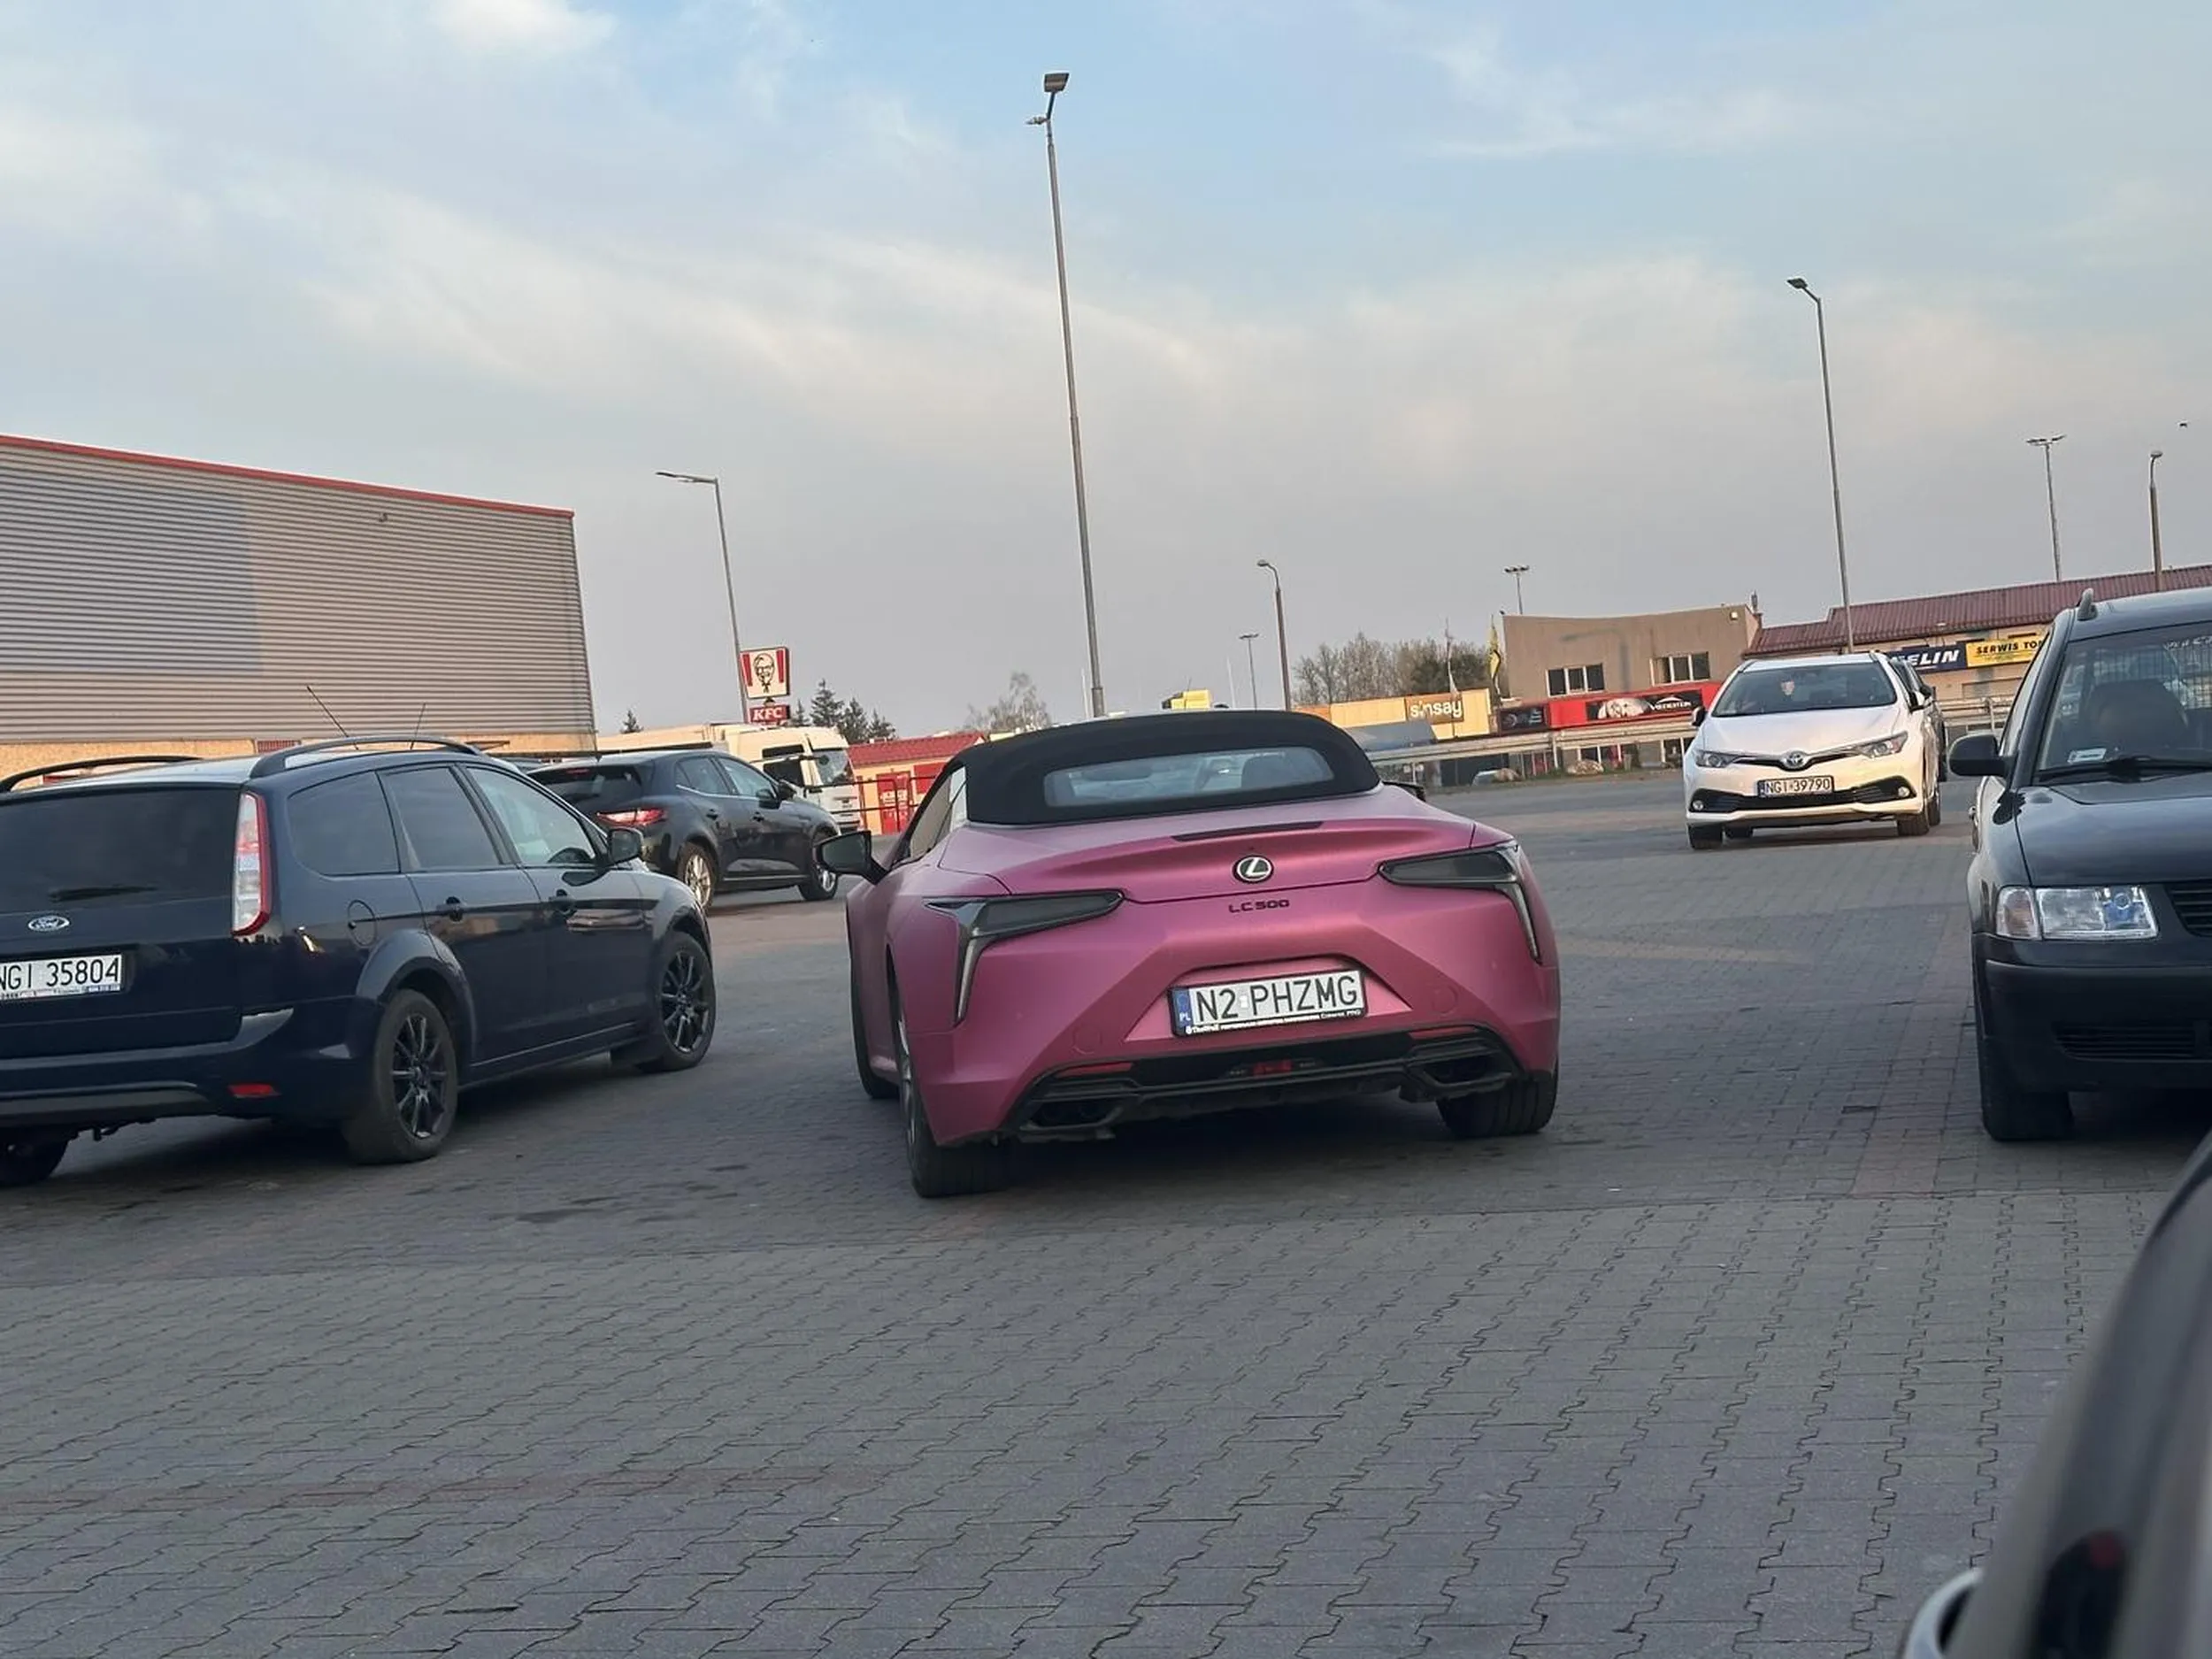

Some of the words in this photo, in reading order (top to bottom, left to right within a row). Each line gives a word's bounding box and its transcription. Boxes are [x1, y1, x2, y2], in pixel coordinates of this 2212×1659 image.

[1976, 643, 2018, 654] SERWIS
[752, 708, 782, 721] KFC
[1409, 700, 1462, 718] sinsay
[1766, 781, 1788, 794] NGI
[1793, 778, 1830, 792] 39790
[1228, 902, 1253, 914] LC
[1256, 899, 1290, 910] 500
[46, 956, 119, 987] 35804
[1195, 987, 1239, 1022] N2
[1249, 974, 1358, 1016] PHZMG
